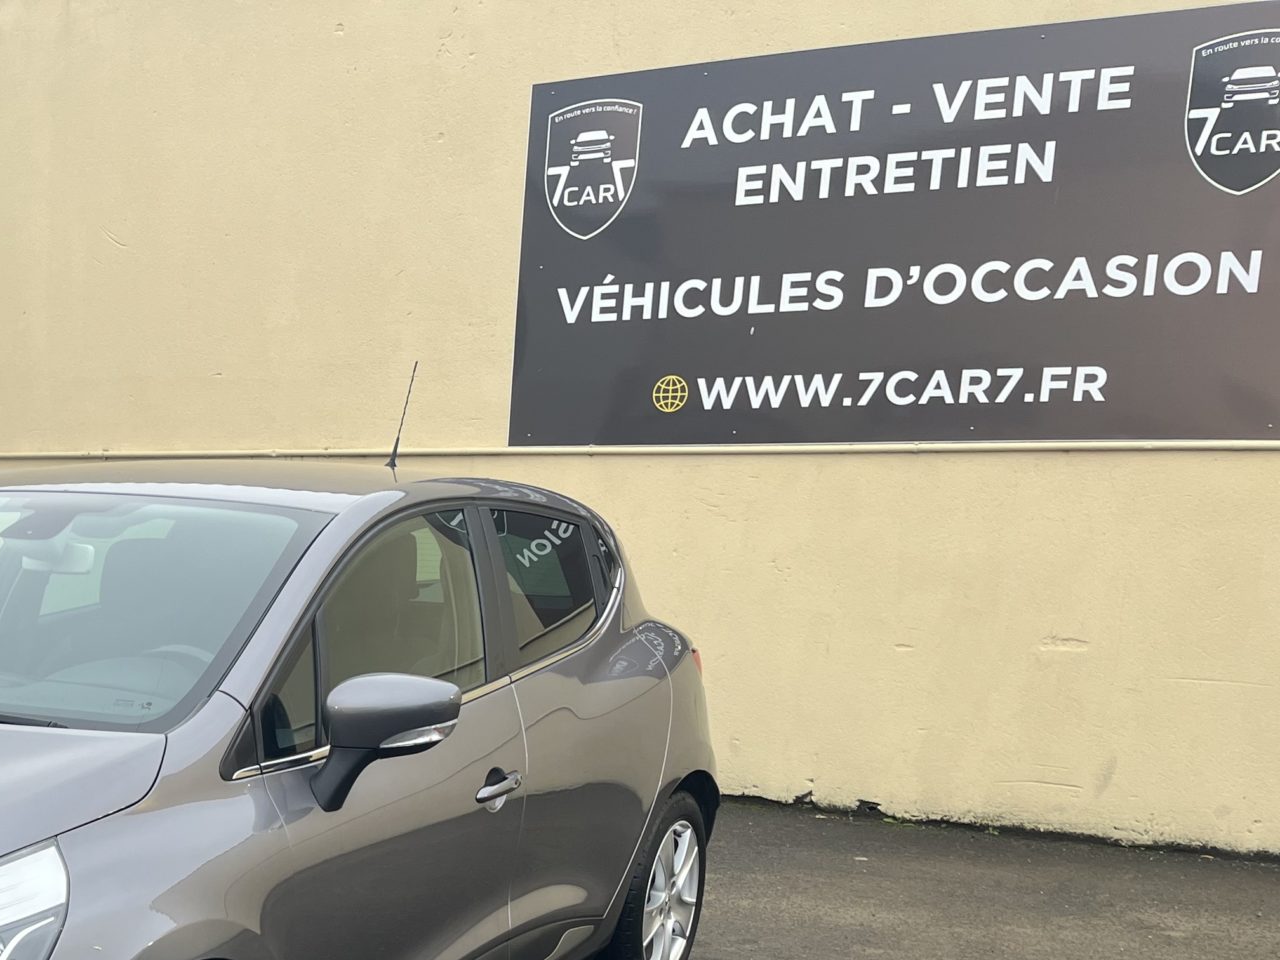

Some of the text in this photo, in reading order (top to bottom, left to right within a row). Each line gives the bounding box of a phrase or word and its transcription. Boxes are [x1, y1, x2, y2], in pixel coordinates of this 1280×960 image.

[1201, 48, 1213, 57] En
[1214, 41, 1238, 53] route
[1240, 38, 1259, 48] vers
[1260, 36, 1269, 44] la
[554, 115, 564, 123] En
[564, 109, 581, 120] route
[581, 106, 595, 115] vers
[680, 89, 875, 149] ACHAT
[932, 65, 1135, 123] VENTE
[547, 158, 636, 207] 7CAR7
[735, 140, 1057, 206] ENTRETIEN
[557, 250, 1263, 324] VÉHICULES D'OCCASION
[697, 366, 1108, 410] WWW.7CAR7.FR
